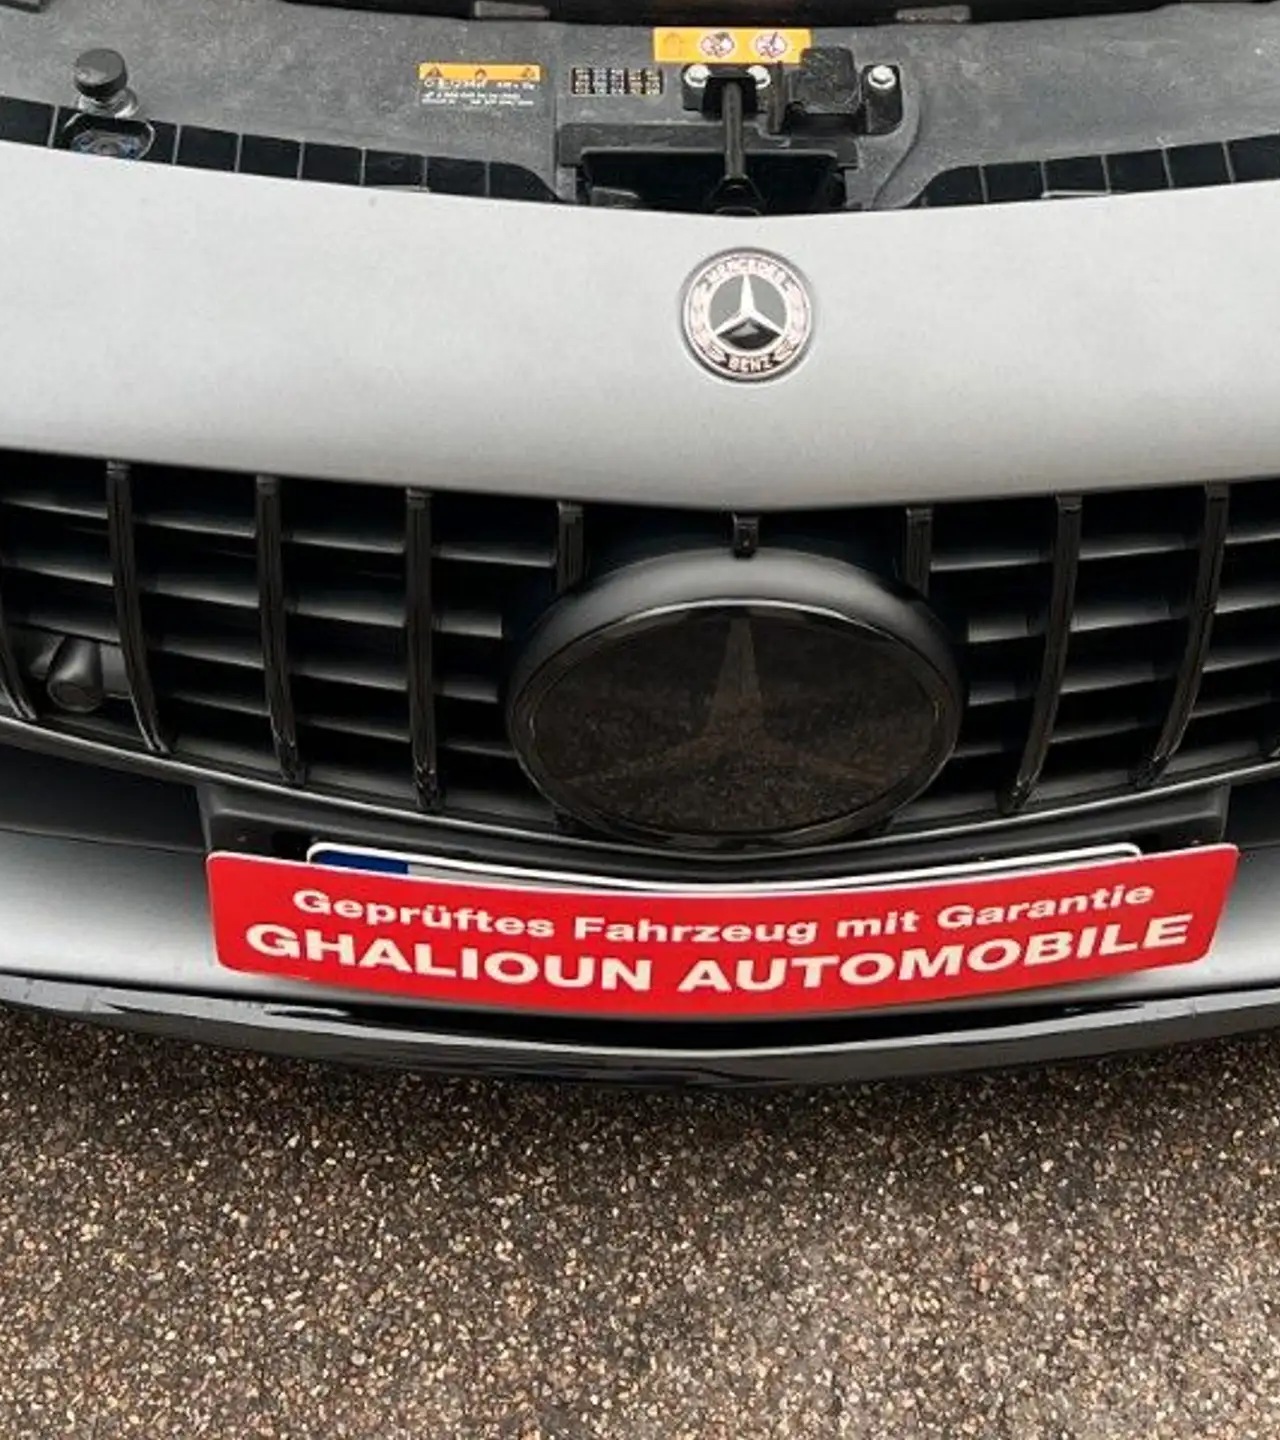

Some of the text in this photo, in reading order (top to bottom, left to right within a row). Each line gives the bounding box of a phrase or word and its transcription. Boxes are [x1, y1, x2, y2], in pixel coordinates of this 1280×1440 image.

[292, 883, 1156, 945] Geprüftes Fahrzeug mit Garantie
[245, 913, 1193, 993] GHALIOUN AUTOMOBILE
